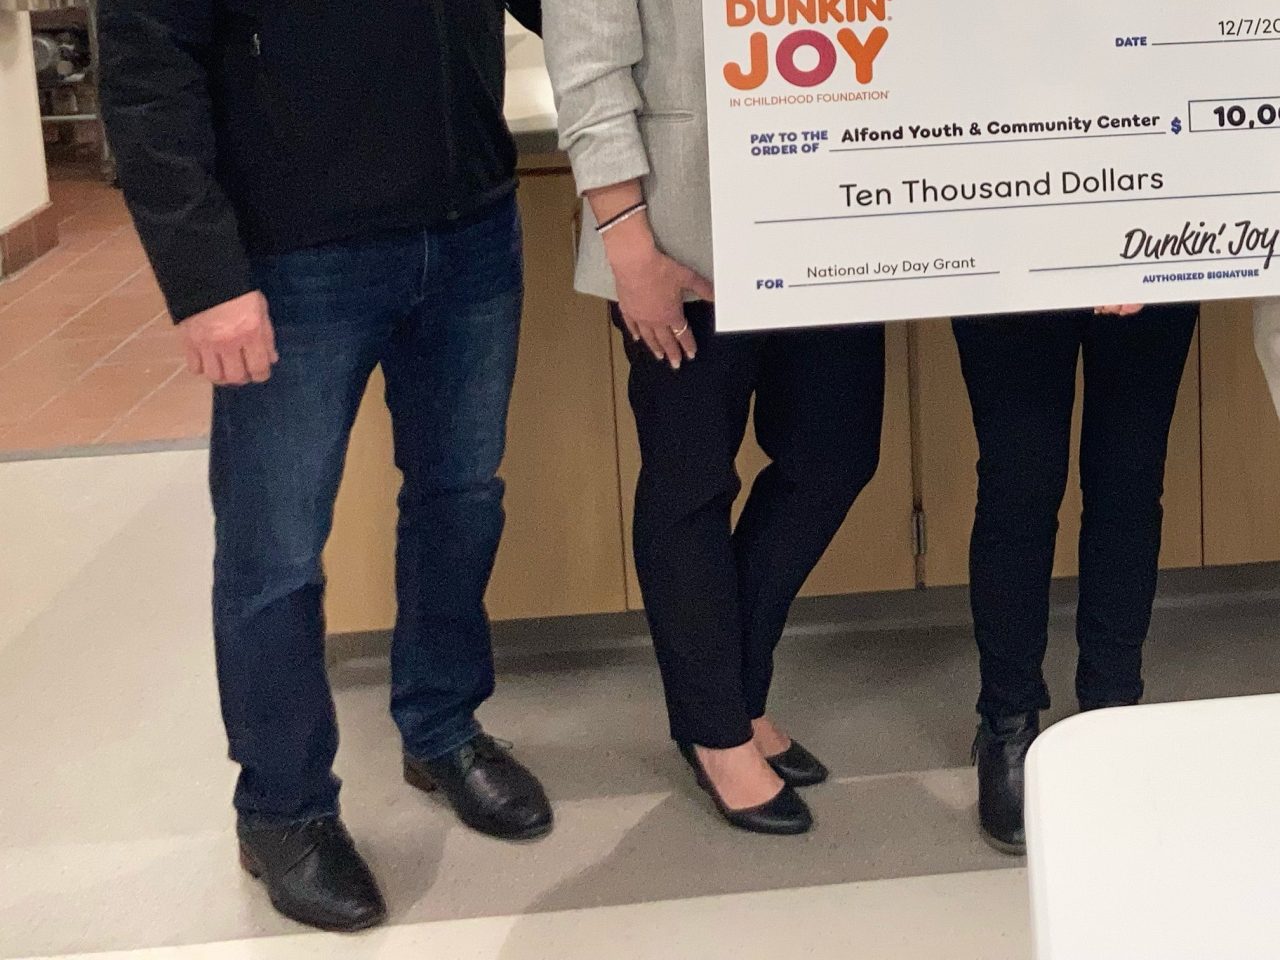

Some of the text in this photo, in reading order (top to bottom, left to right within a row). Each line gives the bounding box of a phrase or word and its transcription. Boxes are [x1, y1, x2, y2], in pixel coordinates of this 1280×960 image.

[1115, 37, 1147, 47] DATE
[723, 26, 889, 91] JOY
[729, 91, 889, 107] IN CHILDHOOD FOUNDATION
[841, 114, 1160, 143] Alfond Youth & Community Center
[1170, 117, 1182, 135] $
[750, 130, 828, 144] PAY TO THE
[751, 143, 819, 156] ORDER OF
[840, 168, 1164, 207] Ten Thousand Dollars
[1228, 220, 1280, 270] Joy
[807, 256, 976, 279] National Joy Day Grant
[1142, 269, 1260, 283] AUTHORIZED SIGNATURE
[756, 279, 784, 289] FOR
